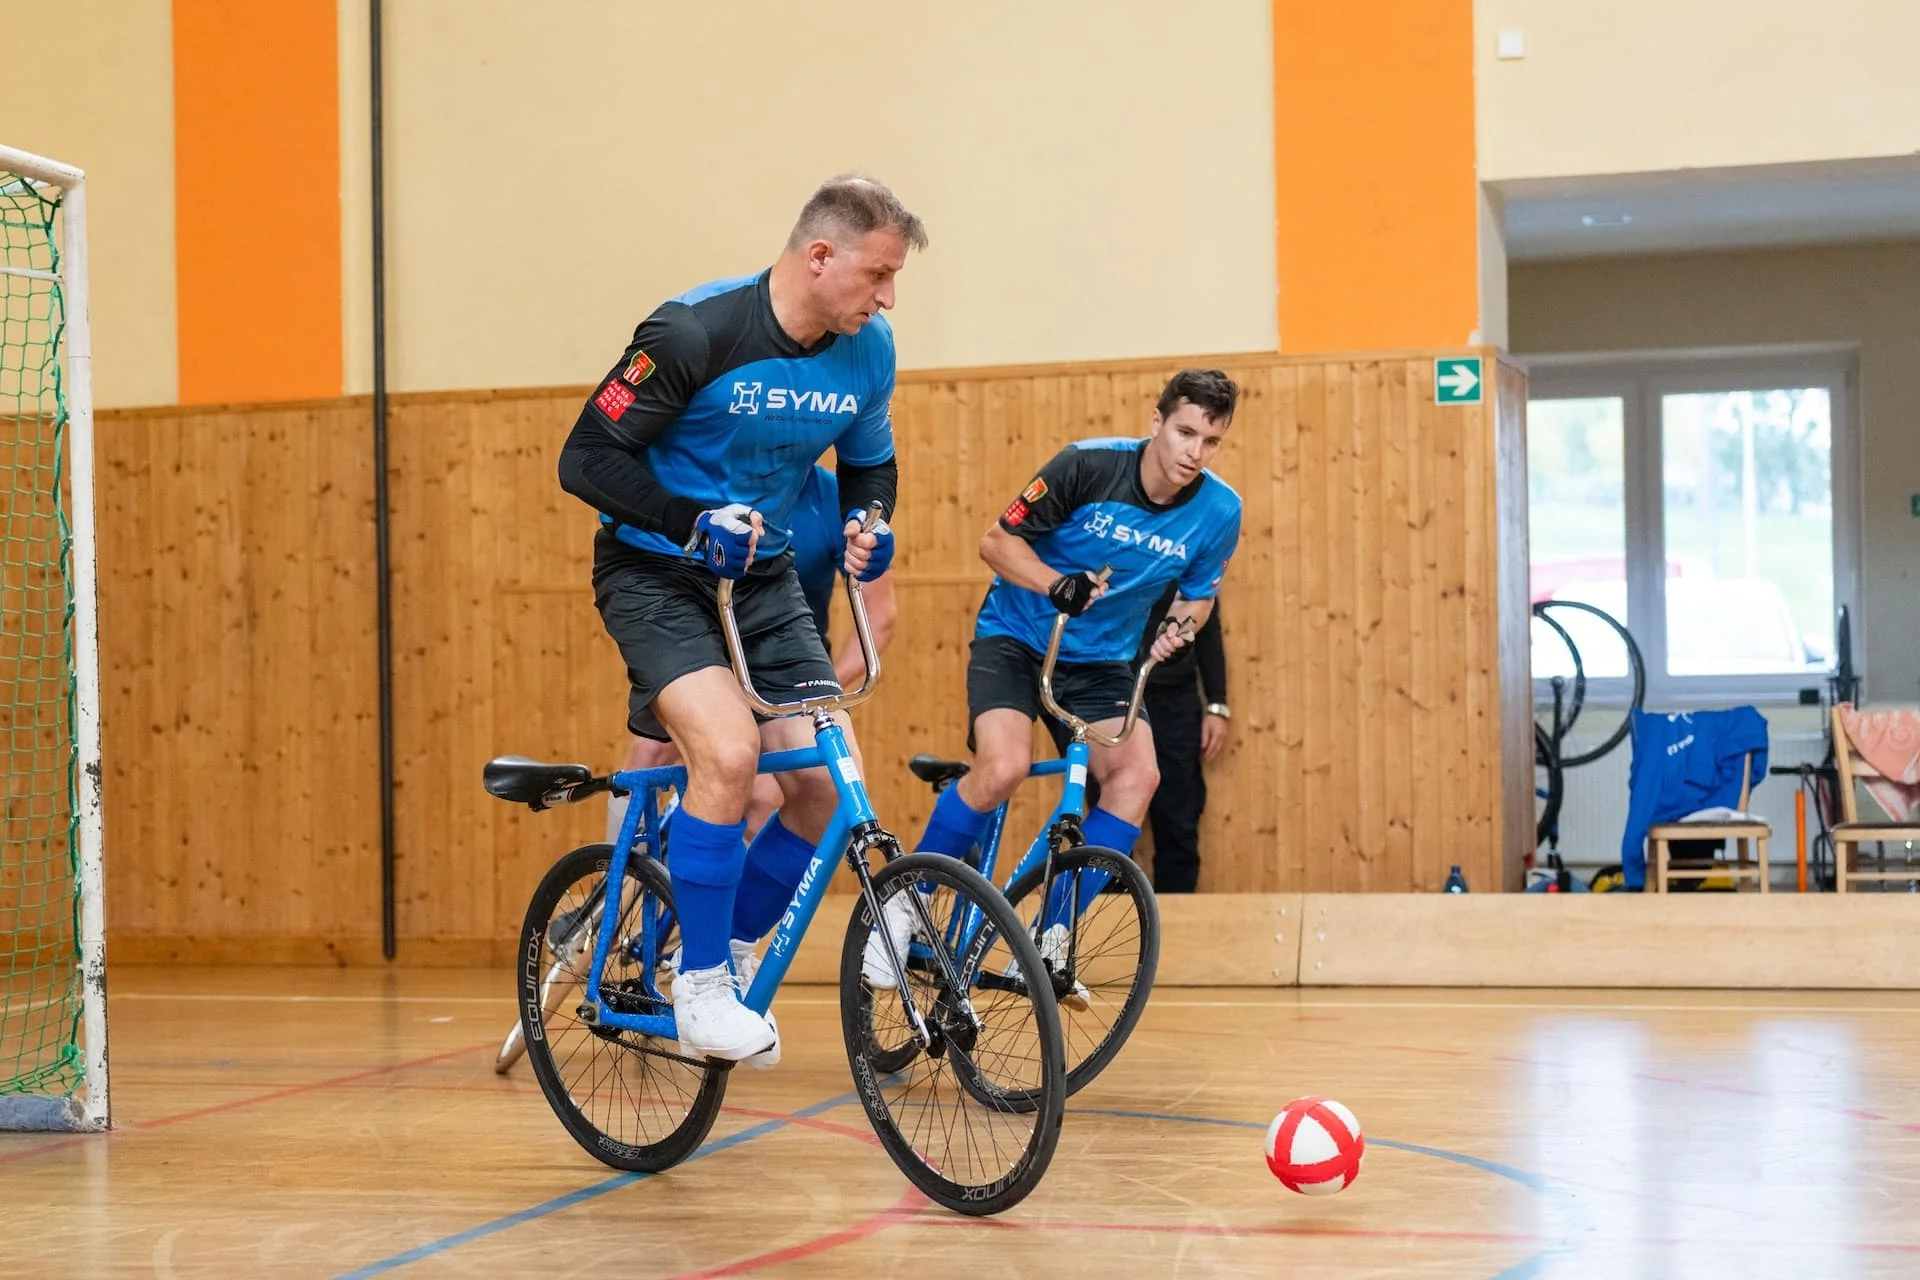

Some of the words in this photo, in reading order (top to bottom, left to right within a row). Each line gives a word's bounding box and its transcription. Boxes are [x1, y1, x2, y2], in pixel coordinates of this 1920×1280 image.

[766, 388, 858, 414] SYMA
[1112, 524, 1187, 560] SYMA
[782, 856, 823, 930] SYMA
[861, 871, 926, 926] EUINOX
[526, 927, 543, 1041] EQUINOX
